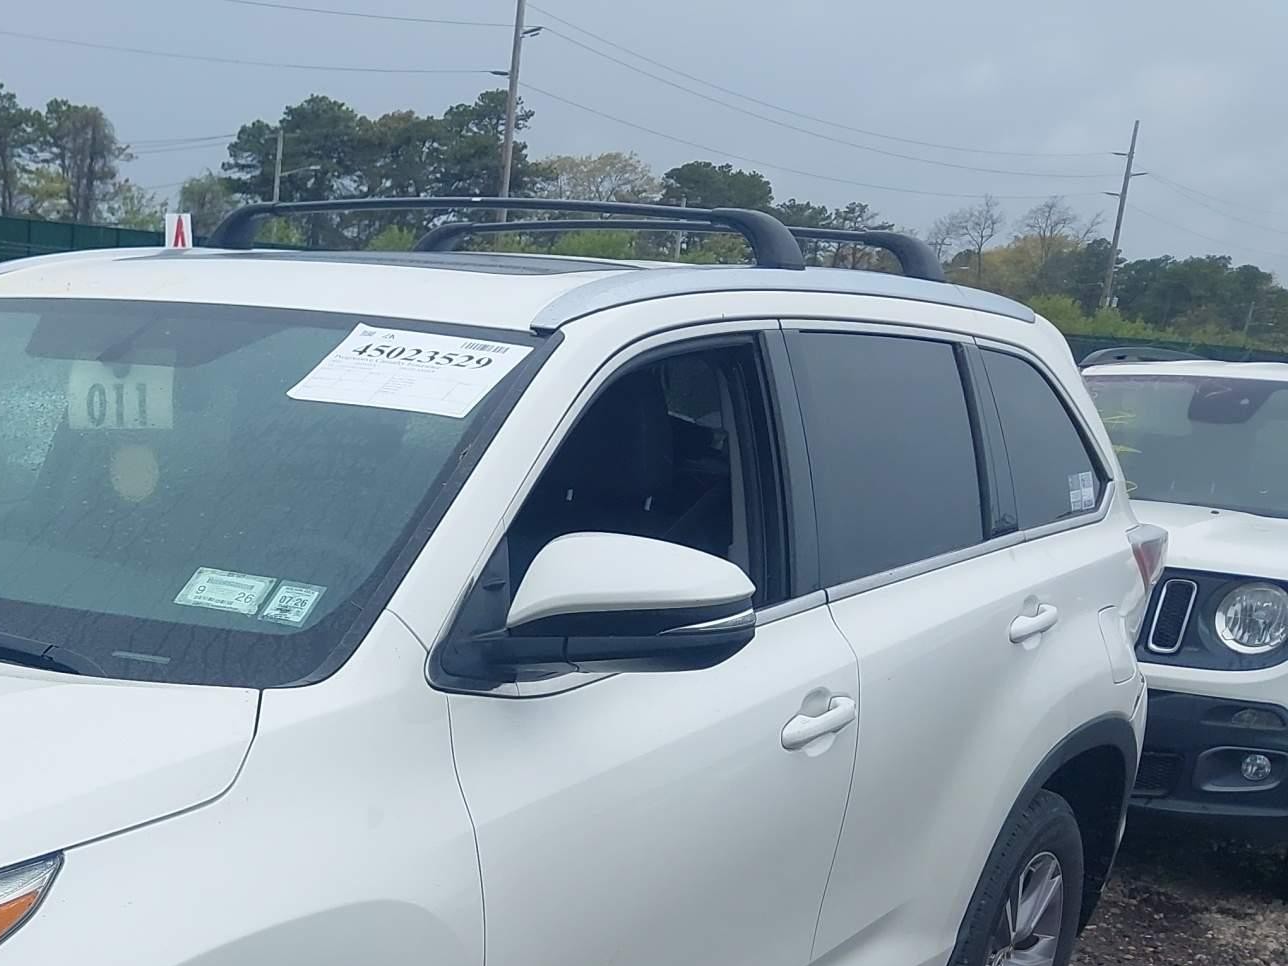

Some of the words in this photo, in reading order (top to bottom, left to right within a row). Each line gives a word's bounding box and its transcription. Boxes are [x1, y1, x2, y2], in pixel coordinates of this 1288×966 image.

[173, 214, 187, 248] A
[352, 343, 495, 370] 45023529
[234, 592, 256, 604] 26
